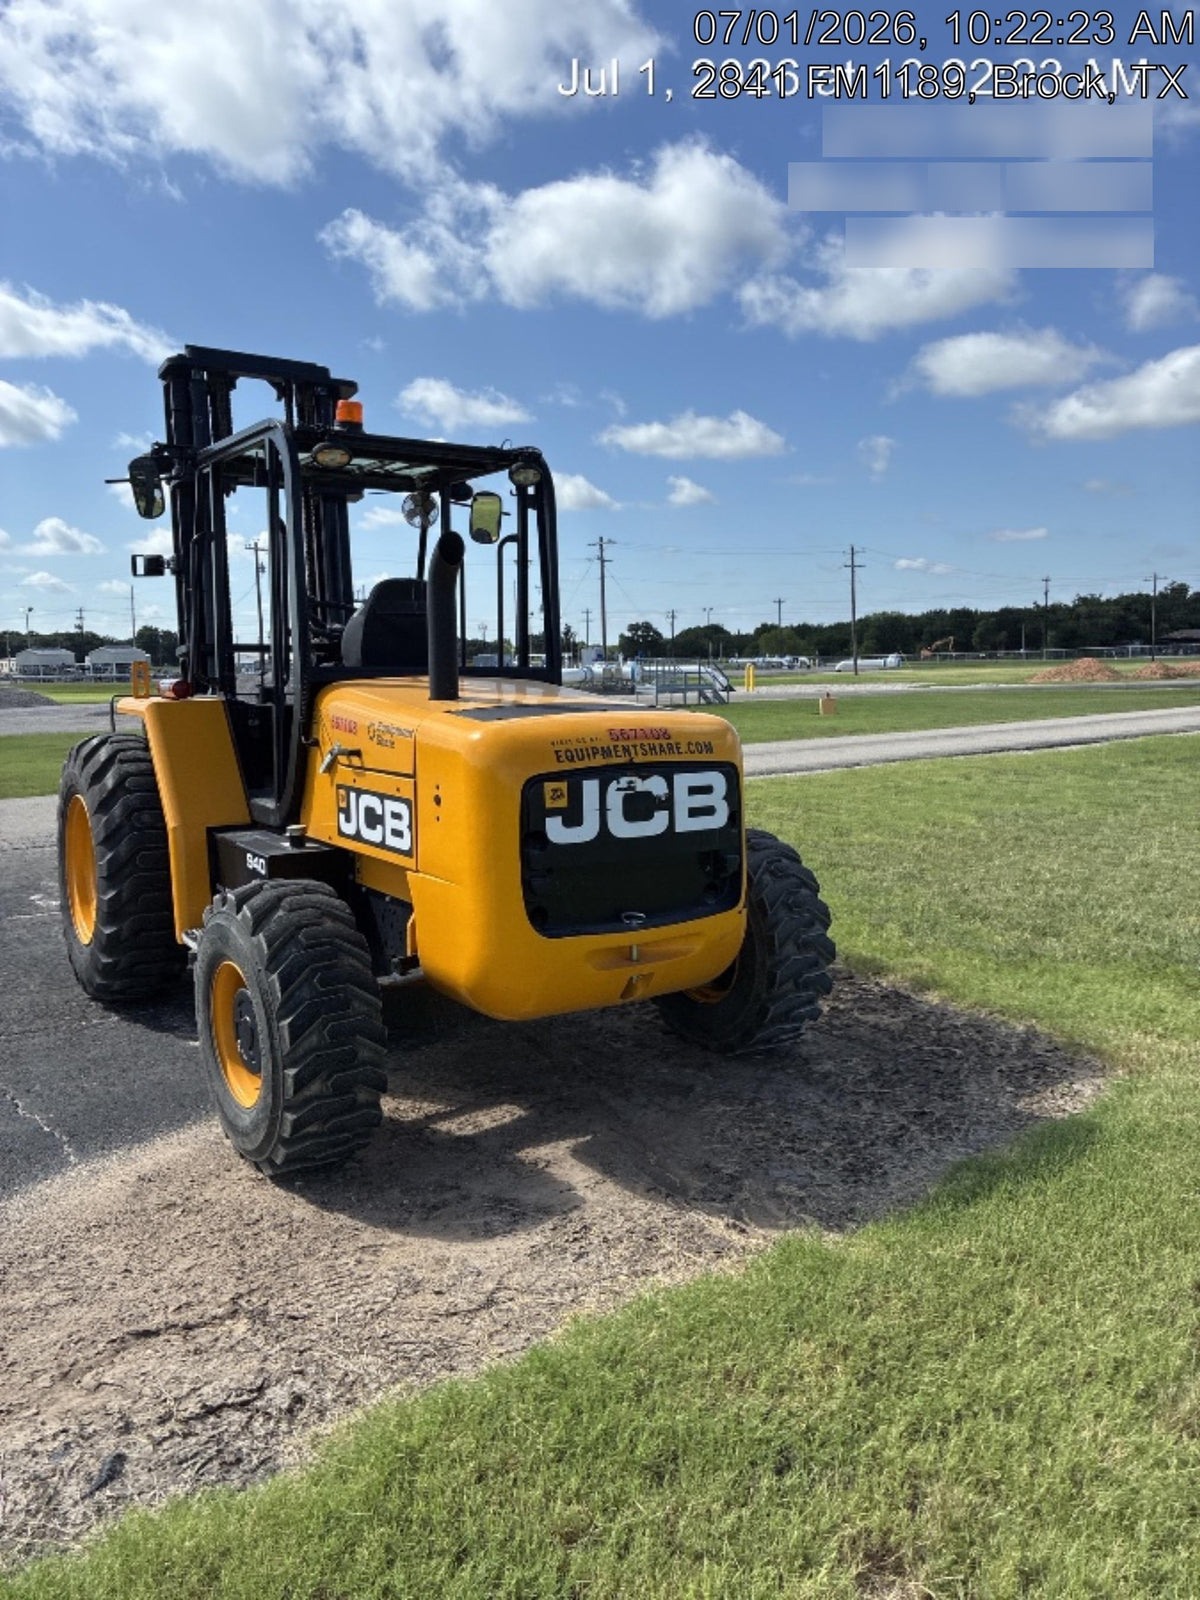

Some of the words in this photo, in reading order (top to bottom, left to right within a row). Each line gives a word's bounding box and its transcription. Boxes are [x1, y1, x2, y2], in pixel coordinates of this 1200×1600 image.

[554, 741, 714, 763] EQUIPMENTSHARE.COM
[339, 791, 411, 851] JCB
[545, 771, 729, 845] JCB
